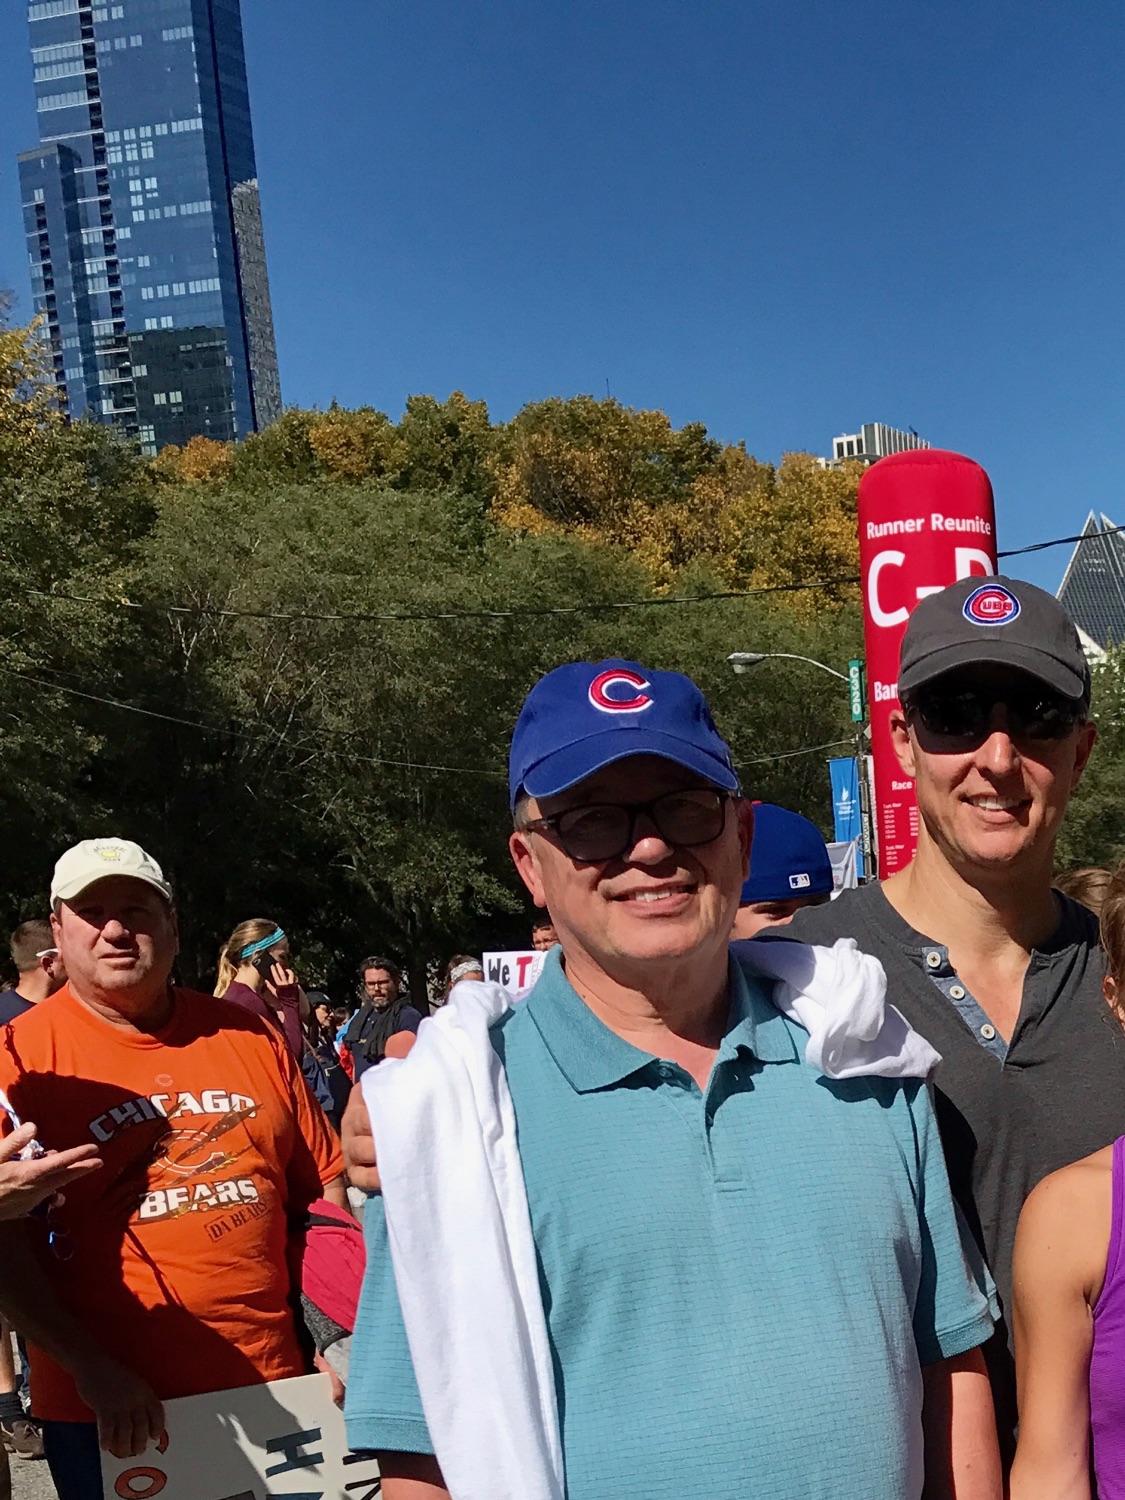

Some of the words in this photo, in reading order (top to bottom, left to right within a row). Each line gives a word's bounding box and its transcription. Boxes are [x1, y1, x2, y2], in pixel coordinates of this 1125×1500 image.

[866, 518, 925, 540] Runner
[930, 513, 991, 535] Reunite
[588, 668, 654, 714] C
[849, 666, 862, 715] C320
[873, 681, 899, 703] Ban
[891, 780, 913, 791] Race
[488, 957, 511, 986] We
[89, 1089, 258, 1142] CHICAGO
[139, 1179, 259, 1219] BEARS
[209, 1220, 231, 1239] DA
[230, 1200, 268, 1228] BEARS
